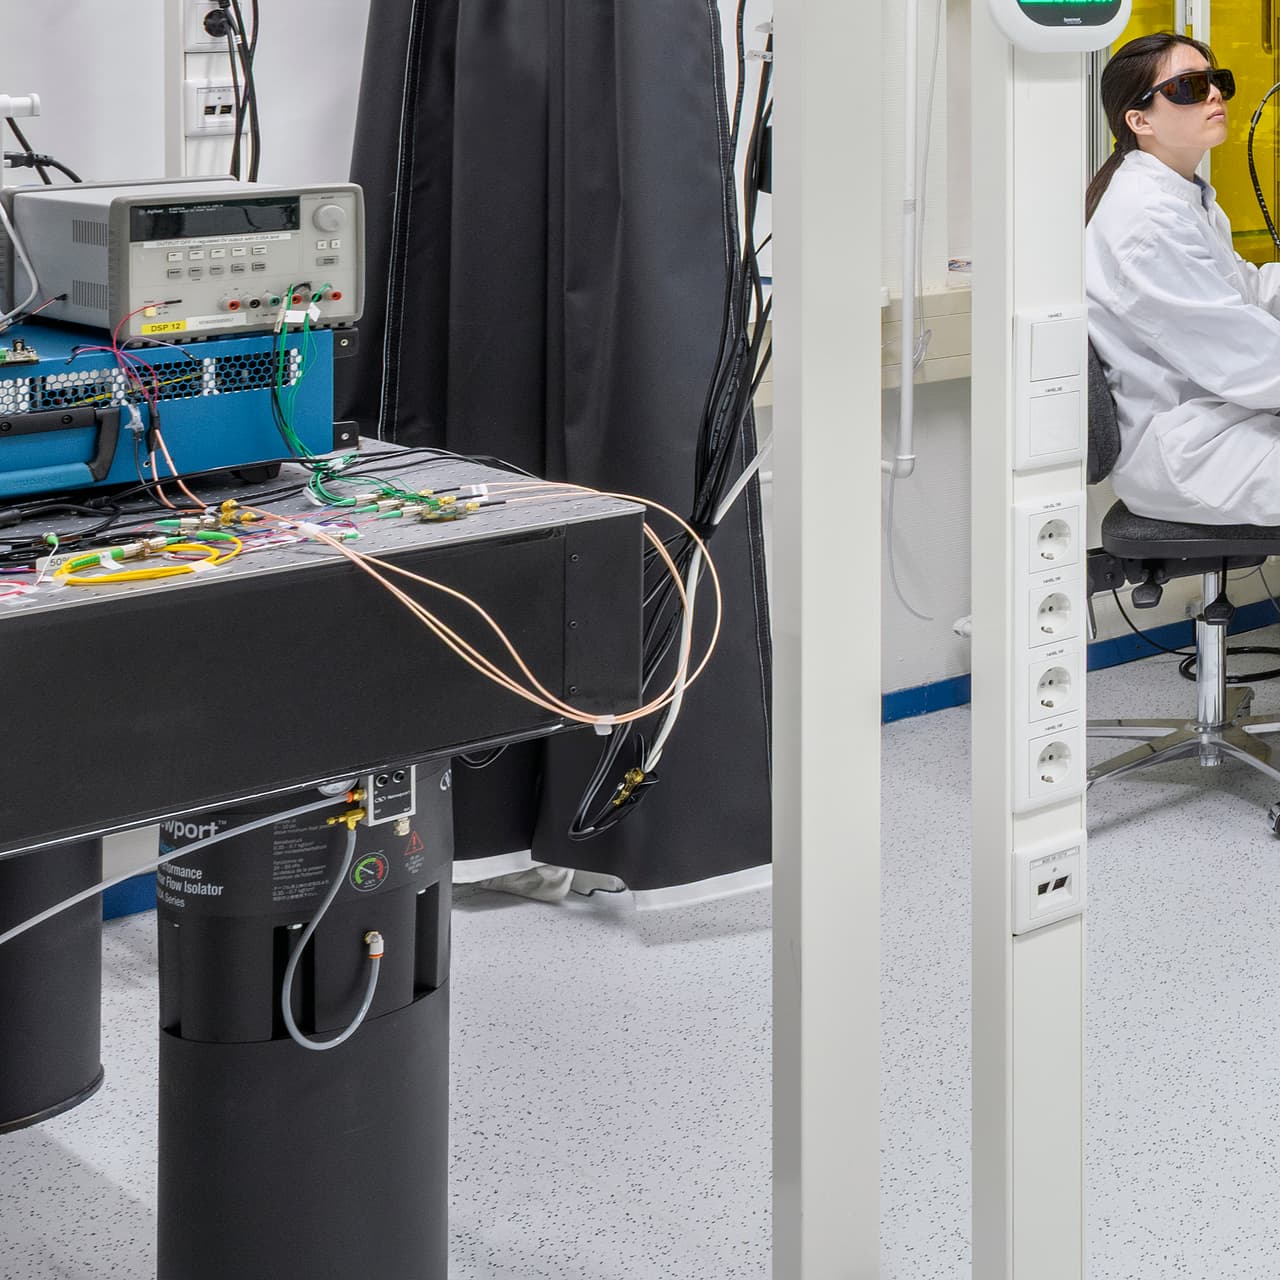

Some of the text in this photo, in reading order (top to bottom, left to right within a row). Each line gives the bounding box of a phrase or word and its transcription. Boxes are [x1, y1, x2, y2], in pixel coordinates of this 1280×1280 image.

[151, 323, 181, 333] DSP 12
[166, 875, 224, 896] Flow Isolator
